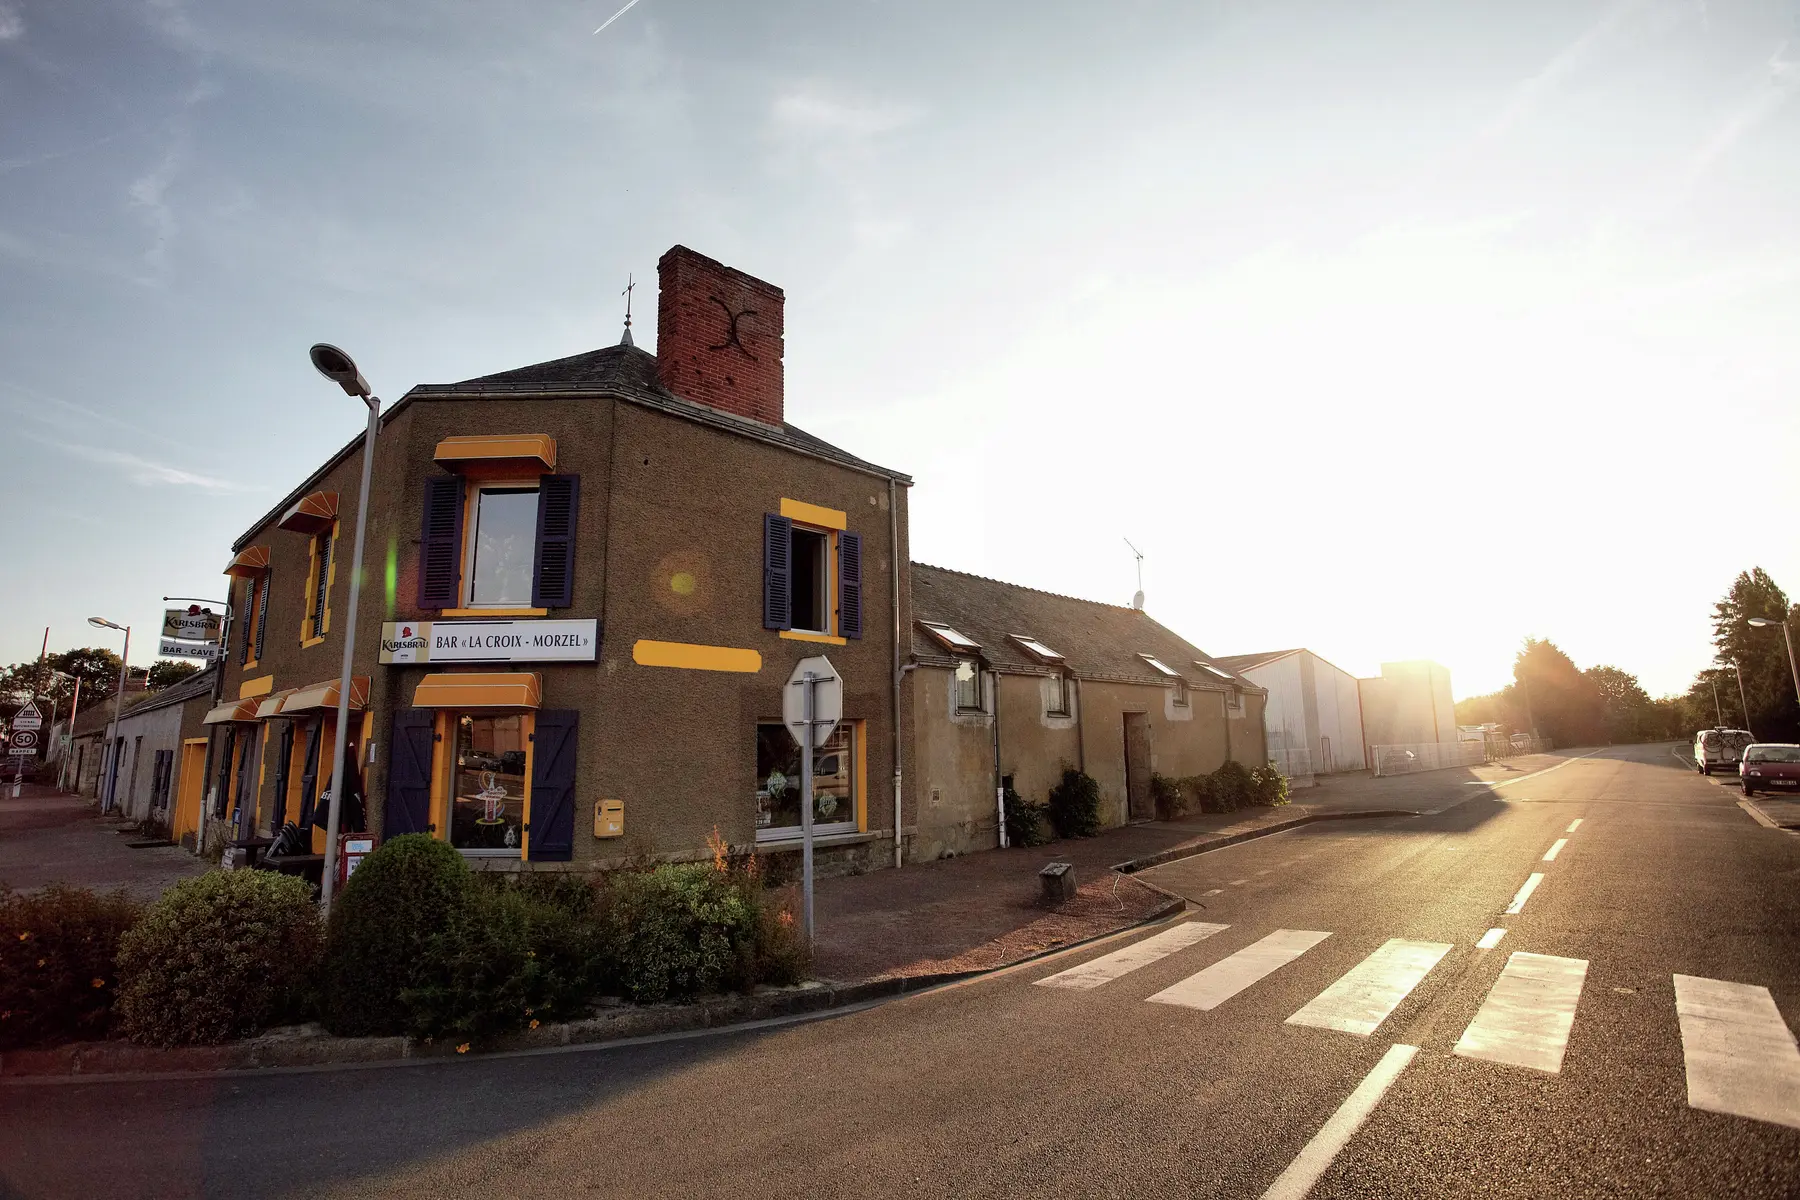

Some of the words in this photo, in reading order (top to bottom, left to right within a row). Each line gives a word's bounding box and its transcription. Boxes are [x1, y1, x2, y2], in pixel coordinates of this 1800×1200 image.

[436, 636, 458, 648] BAR
[485, 635, 522, 648] CROIX
[190, 648, 215, 656] CAVE
[17, 735, 32, 743] 50
